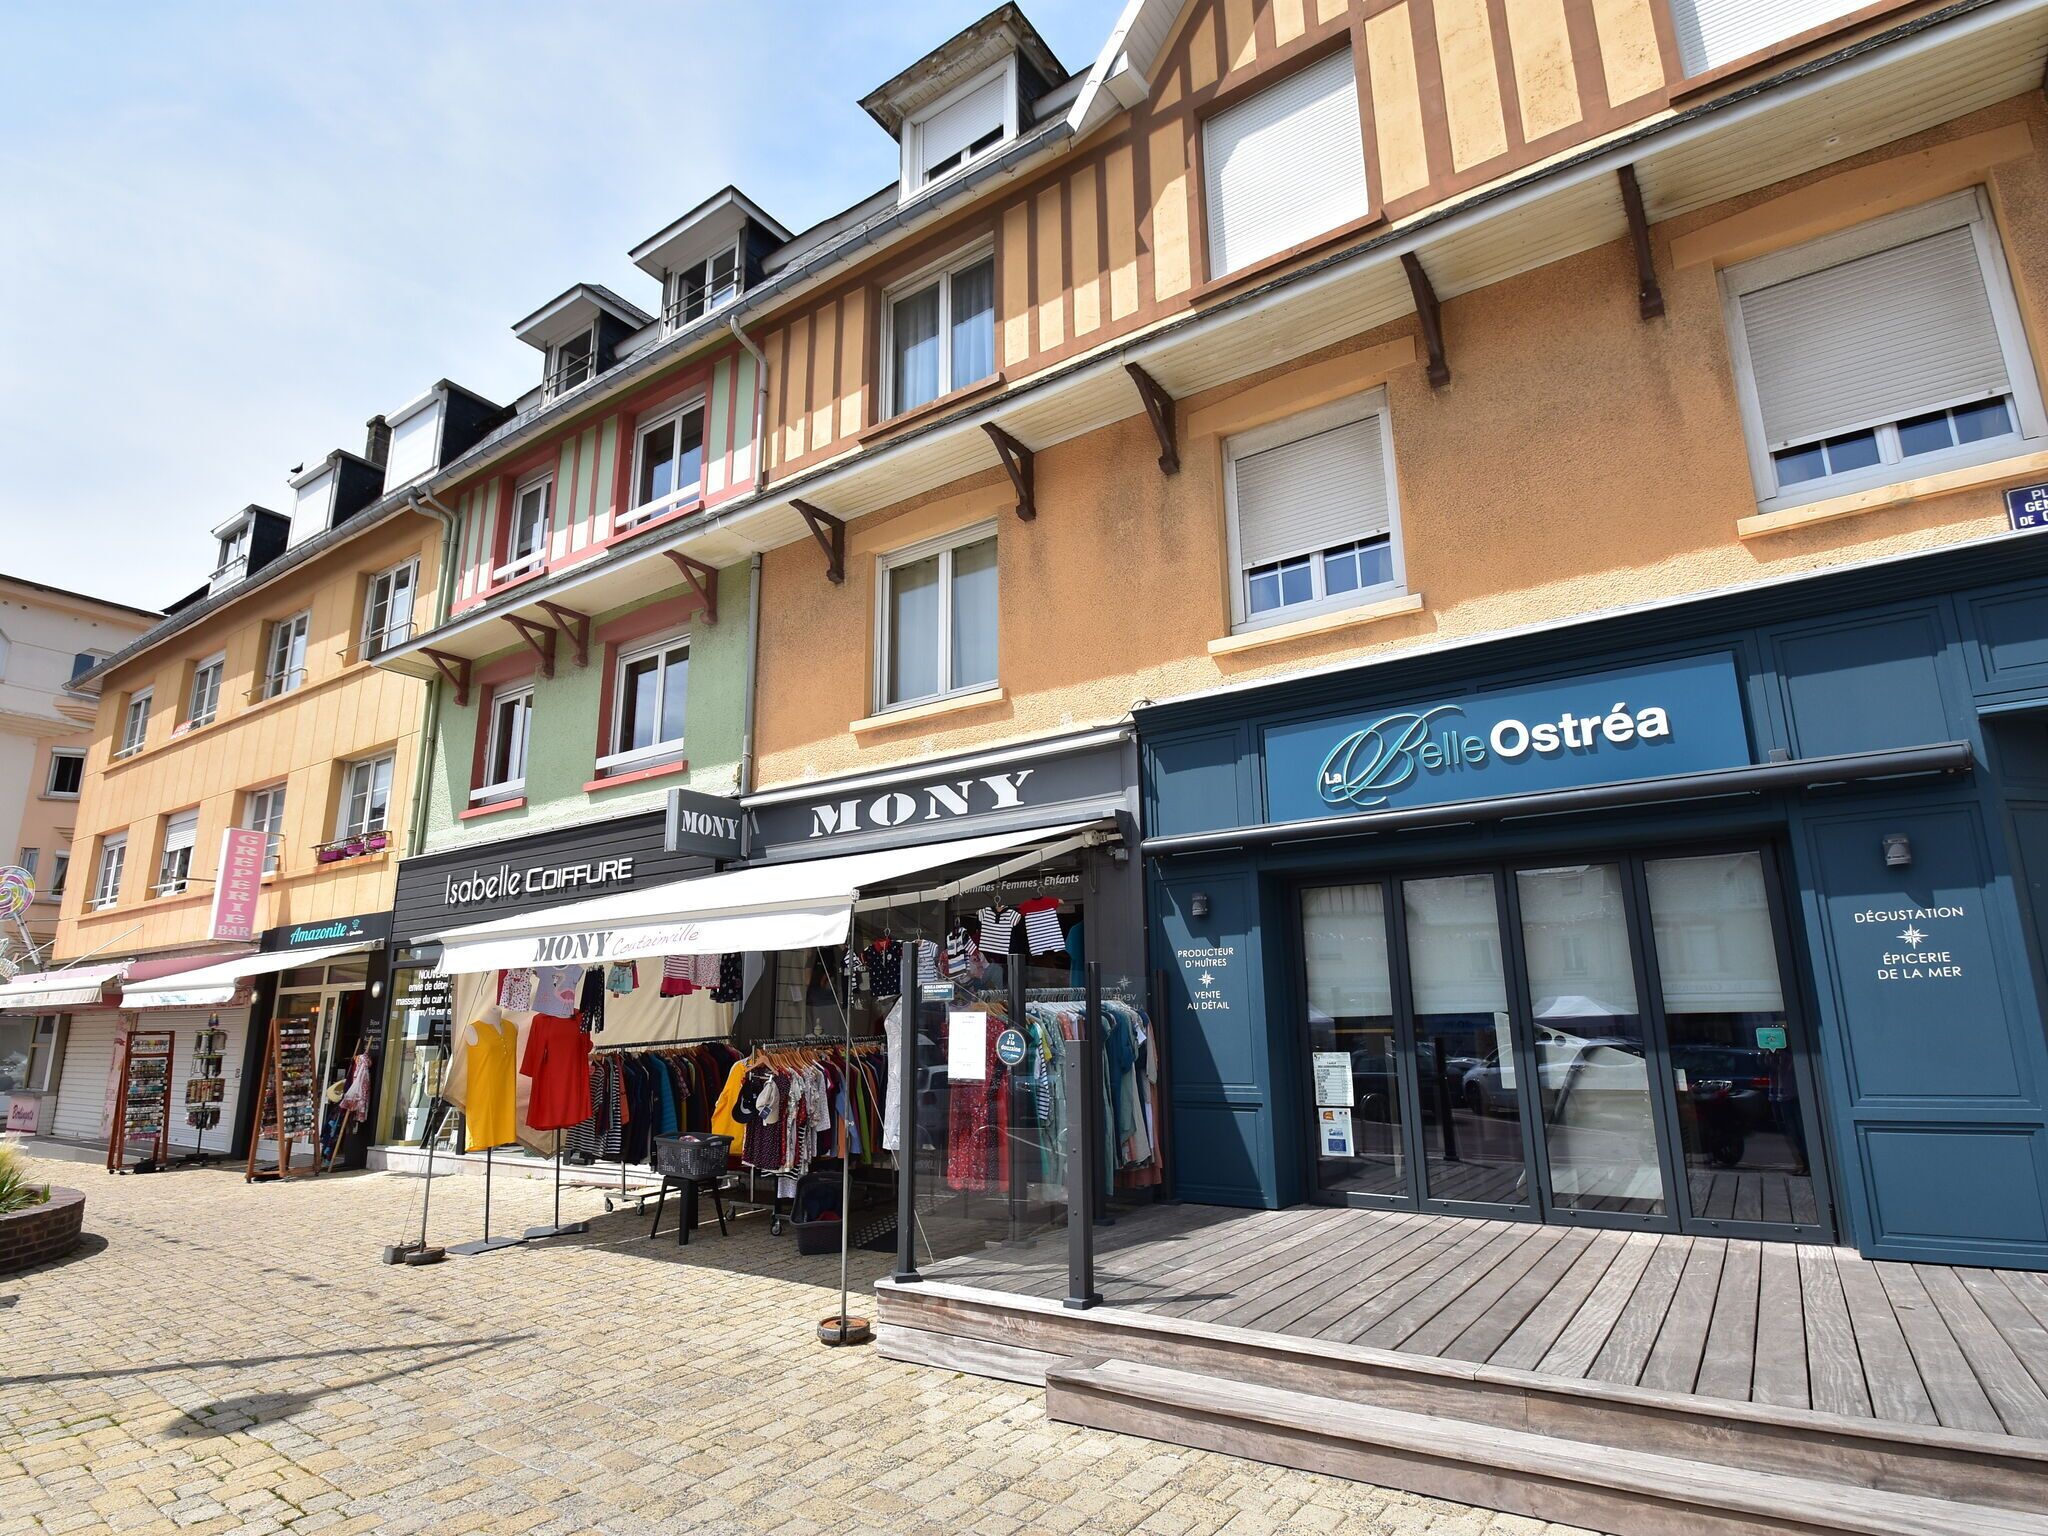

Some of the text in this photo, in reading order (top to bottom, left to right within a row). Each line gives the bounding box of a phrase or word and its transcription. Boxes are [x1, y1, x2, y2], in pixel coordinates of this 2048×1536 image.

[2019, 515, 2035, 526] DE
[1316, 702, 1670, 806] La Belle Ostréa
[809, 769, 1034, 839] MONY
[682, 809, 739, 840] MONY
[445, 865, 521, 904] Isabelle
[960, 884, 995, 894] ommes
[1001, 880, 1037, 890] Femmes
[1044, 874, 1080, 886] Enfants
[1854, 907, 1964, 923] DÉGUSTATION
[217, 925, 249, 936] BAR
[290, 922, 347, 945] Amazonite
[533, 923, 699, 962] MONY Coutainville
[1177, 947, 1234, 958] PRODUCTEUR
[1883, 952, 1951, 965] ÉPICERIE
[1185, 958, 1227, 968] D'HUÎTRES
[1877, 966, 1962, 979] DE LA MER
[425, 981, 432, 990] de
[396, 997, 421, 1007] massage
[423, 995, 430, 1004] du
[1194, 991, 1221, 999] VENTE
[1187, 1000, 1230, 1010] AU DÉTAIL
[436, 1008, 452, 1016] eurs
